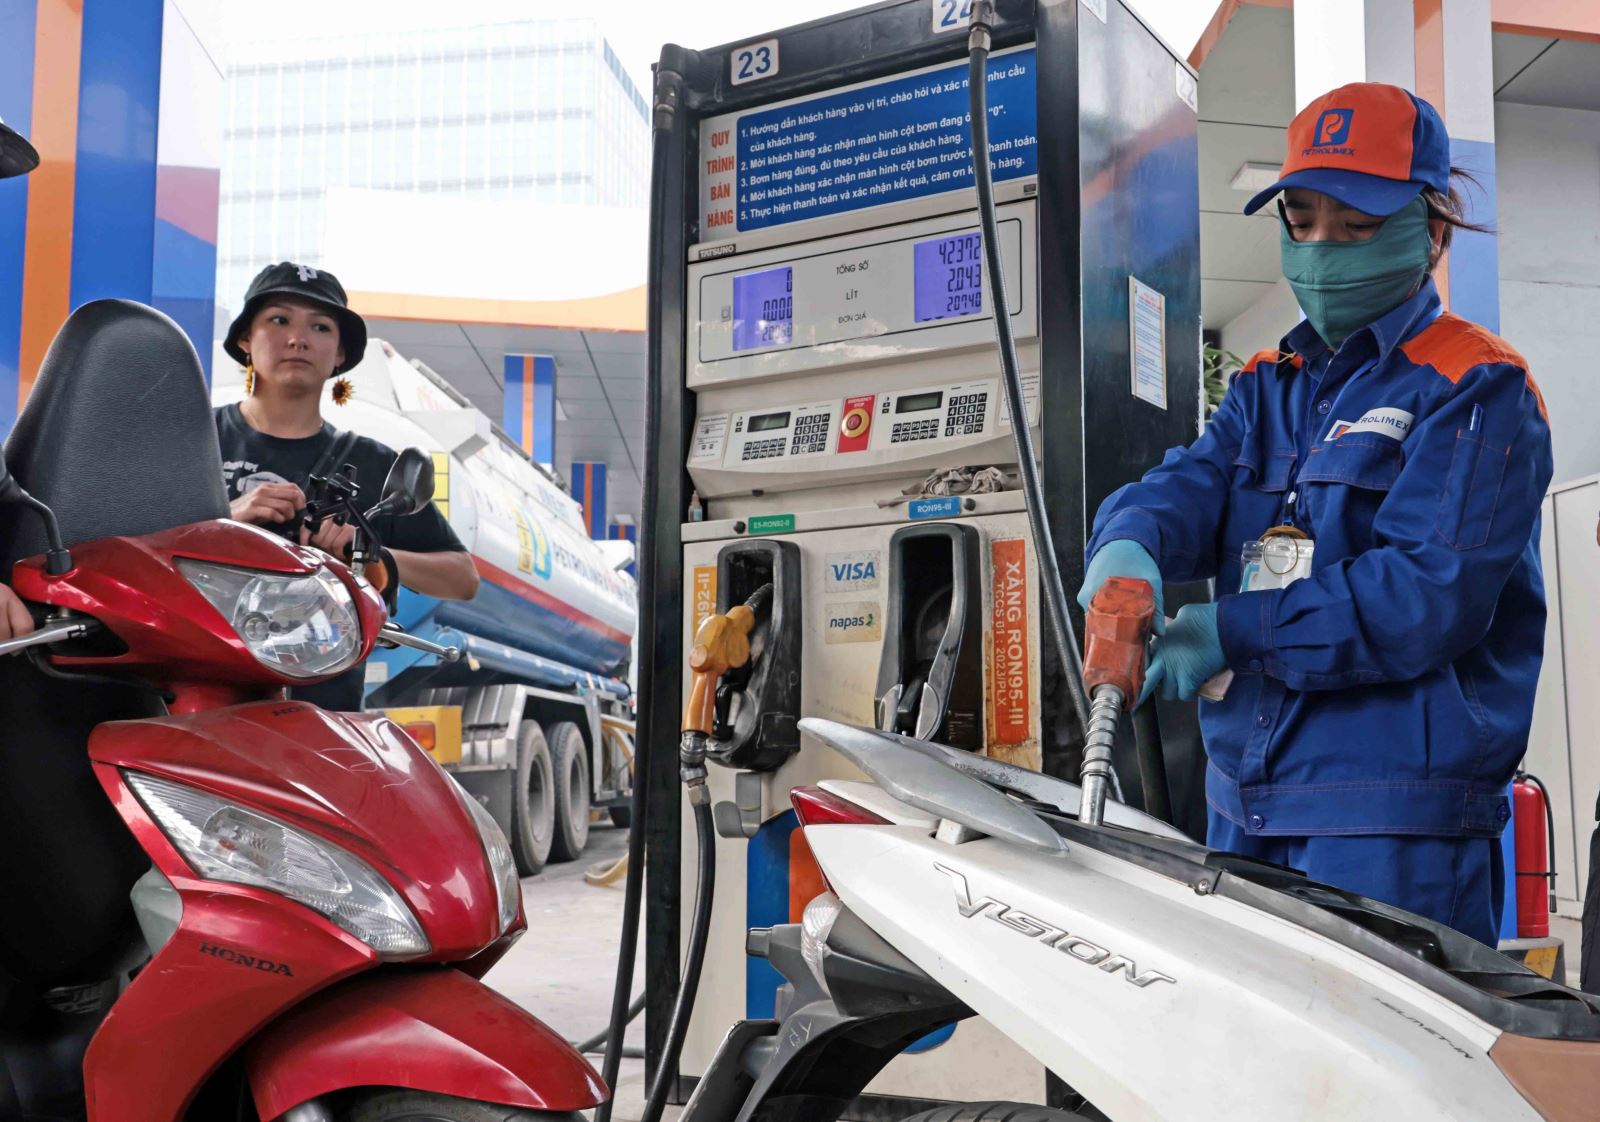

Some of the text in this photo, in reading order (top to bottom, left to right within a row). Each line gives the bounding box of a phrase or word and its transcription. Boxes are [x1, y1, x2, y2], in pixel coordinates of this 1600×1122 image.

[738, 46, 771, 80] 23
[798, 111, 823, 124] khách
[825, 107, 846, 118] hàng
[848, 103, 864, 112] vào
[890, 92, 912, 103] chào
[930, 83, 941, 94] và
[987, 70, 1005, 81] nhu
[711, 130, 730, 149] QUY
[750, 158, 765, 168] Mời
[767, 152, 792, 164] khách
[794, 148, 815, 159] hàng
[834, 138, 855, 150] nhận
[857, 134, 876, 145] màn
[916, 121, 937, 132] bơm
[767, 135, 791, 148] khách
[793, 132, 816, 142] hàng.
[750, 175, 769, 185] Bơm
[771, 170, 792, 180] hàng
[833, 157, 852, 167] theo
[854, 152, 870, 165] yêu
[908, 138, 935, 151] khách
[938, 134, 963, 145] hàng.
[750, 190, 765, 201] Mời
[767, 185, 792, 197] khách
[794, 182, 815, 192] hàng
[834, 172, 855, 184] nhận
[858, 168, 876, 179] màn
[917, 156, 937, 167] bơm
[940, 150, 966, 162] trước
[988, 139, 1011, 153] hanh
[750, 207, 771, 217] Thực
[773, 202, 791, 214] hiện
[793, 197, 816, 209] thanh
[818, 193, 837, 204] toán
[839, 190, 850, 199] và
[869, 182, 891, 194] nhận
[952, 168, 965, 177] ơn
[998, 157, 1024, 168] hàng.
[700, 244, 735, 258] TATSUNO
[939, 236, 981, 265] 42372
[946, 292, 981, 312] 20740
[831, 561, 876, 581] VISA
[995, 581, 1005, 617] TCCS
[830, 616, 865, 631] napas
[1006, 561, 1025, 725] XĂNG RON95-III
[199, 943, 294, 977] HONDA
